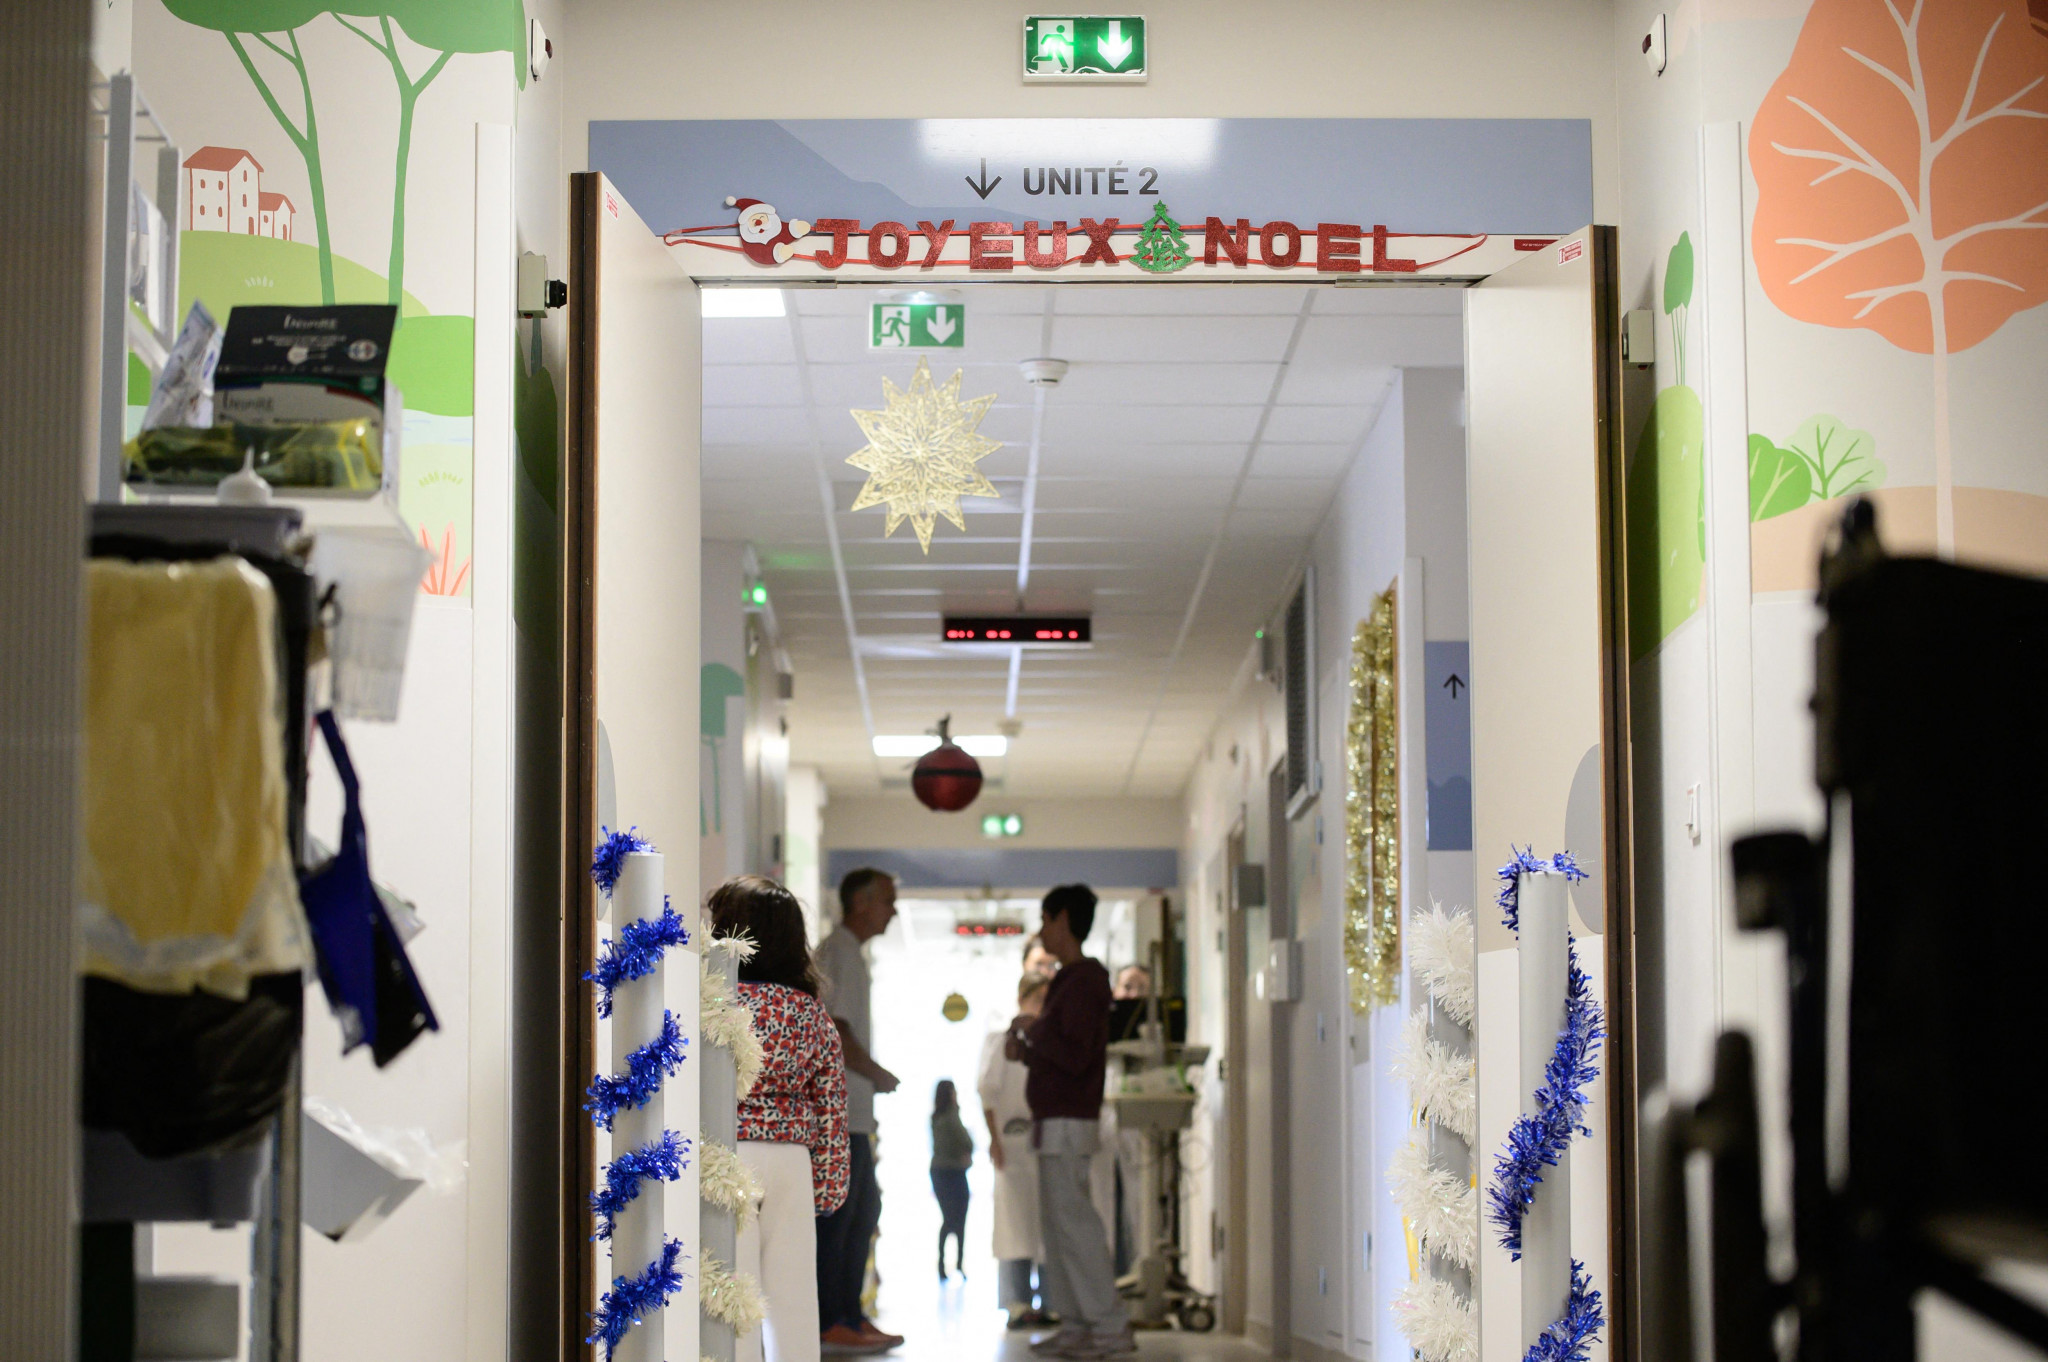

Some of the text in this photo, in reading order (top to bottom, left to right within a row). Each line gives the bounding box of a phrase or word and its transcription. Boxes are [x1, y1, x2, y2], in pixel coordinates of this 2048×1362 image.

[1023, 160, 1159, 196] UNITÉ 2
[815, 216, 1417, 273] JOYEUX NOEL
